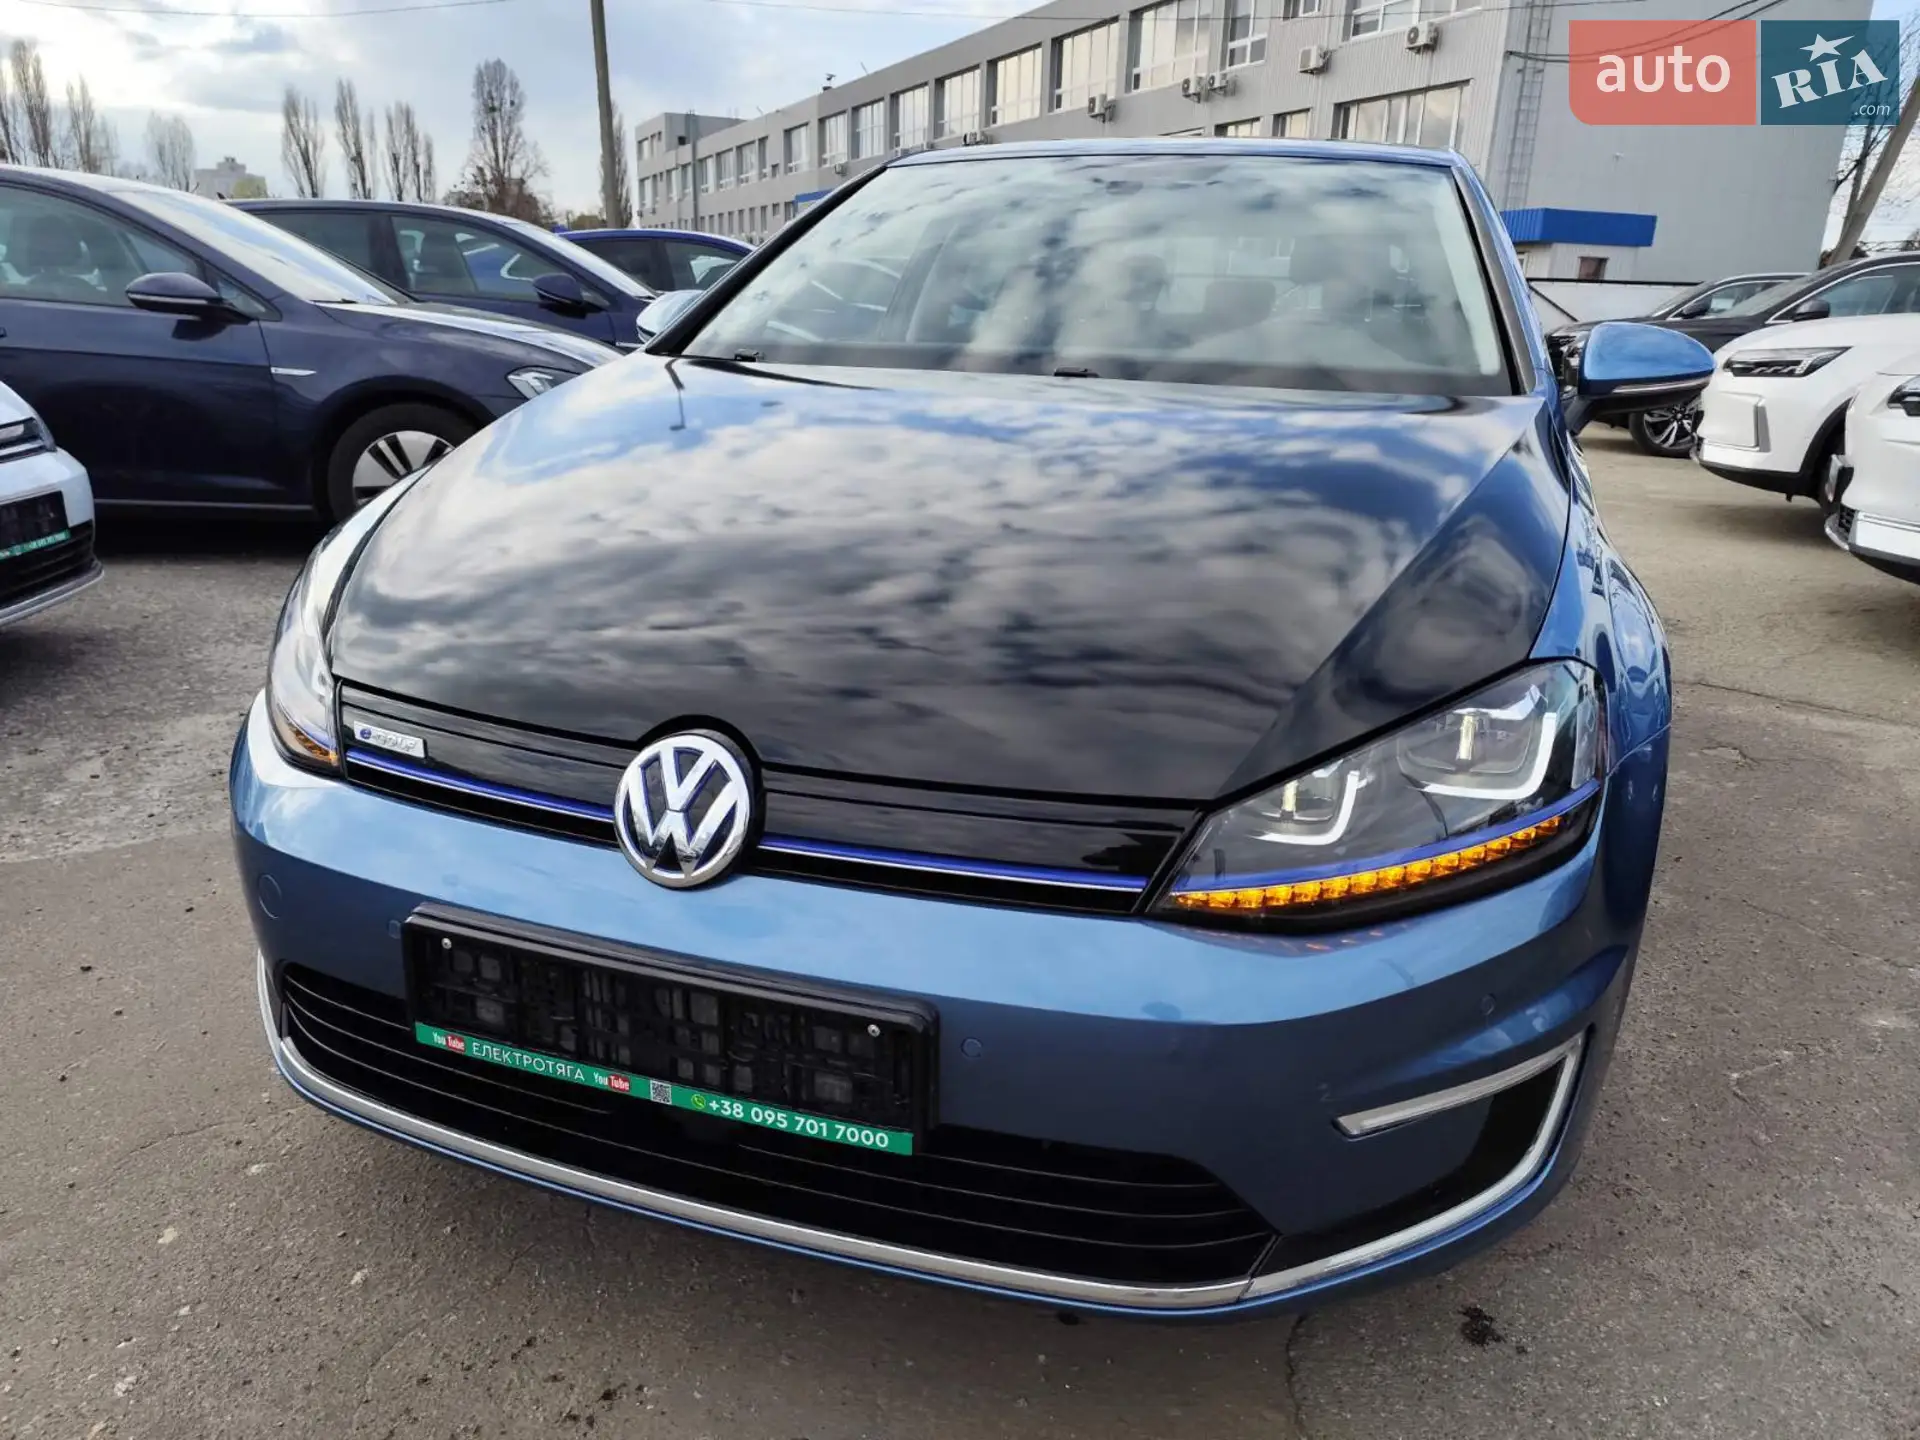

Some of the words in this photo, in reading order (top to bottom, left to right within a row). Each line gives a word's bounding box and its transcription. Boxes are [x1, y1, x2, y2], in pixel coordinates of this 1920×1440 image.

[616, 735, 749, 887] VW
[472, 1042, 585, 1081] ЕЛЕКТРОТЯГА
[709, 1100, 744, 1118] +38
[751, 1107, 788, 1128] 095
[795, 1116, 828, 1136] 701
[835, 1124, 888, 1147] 7000
